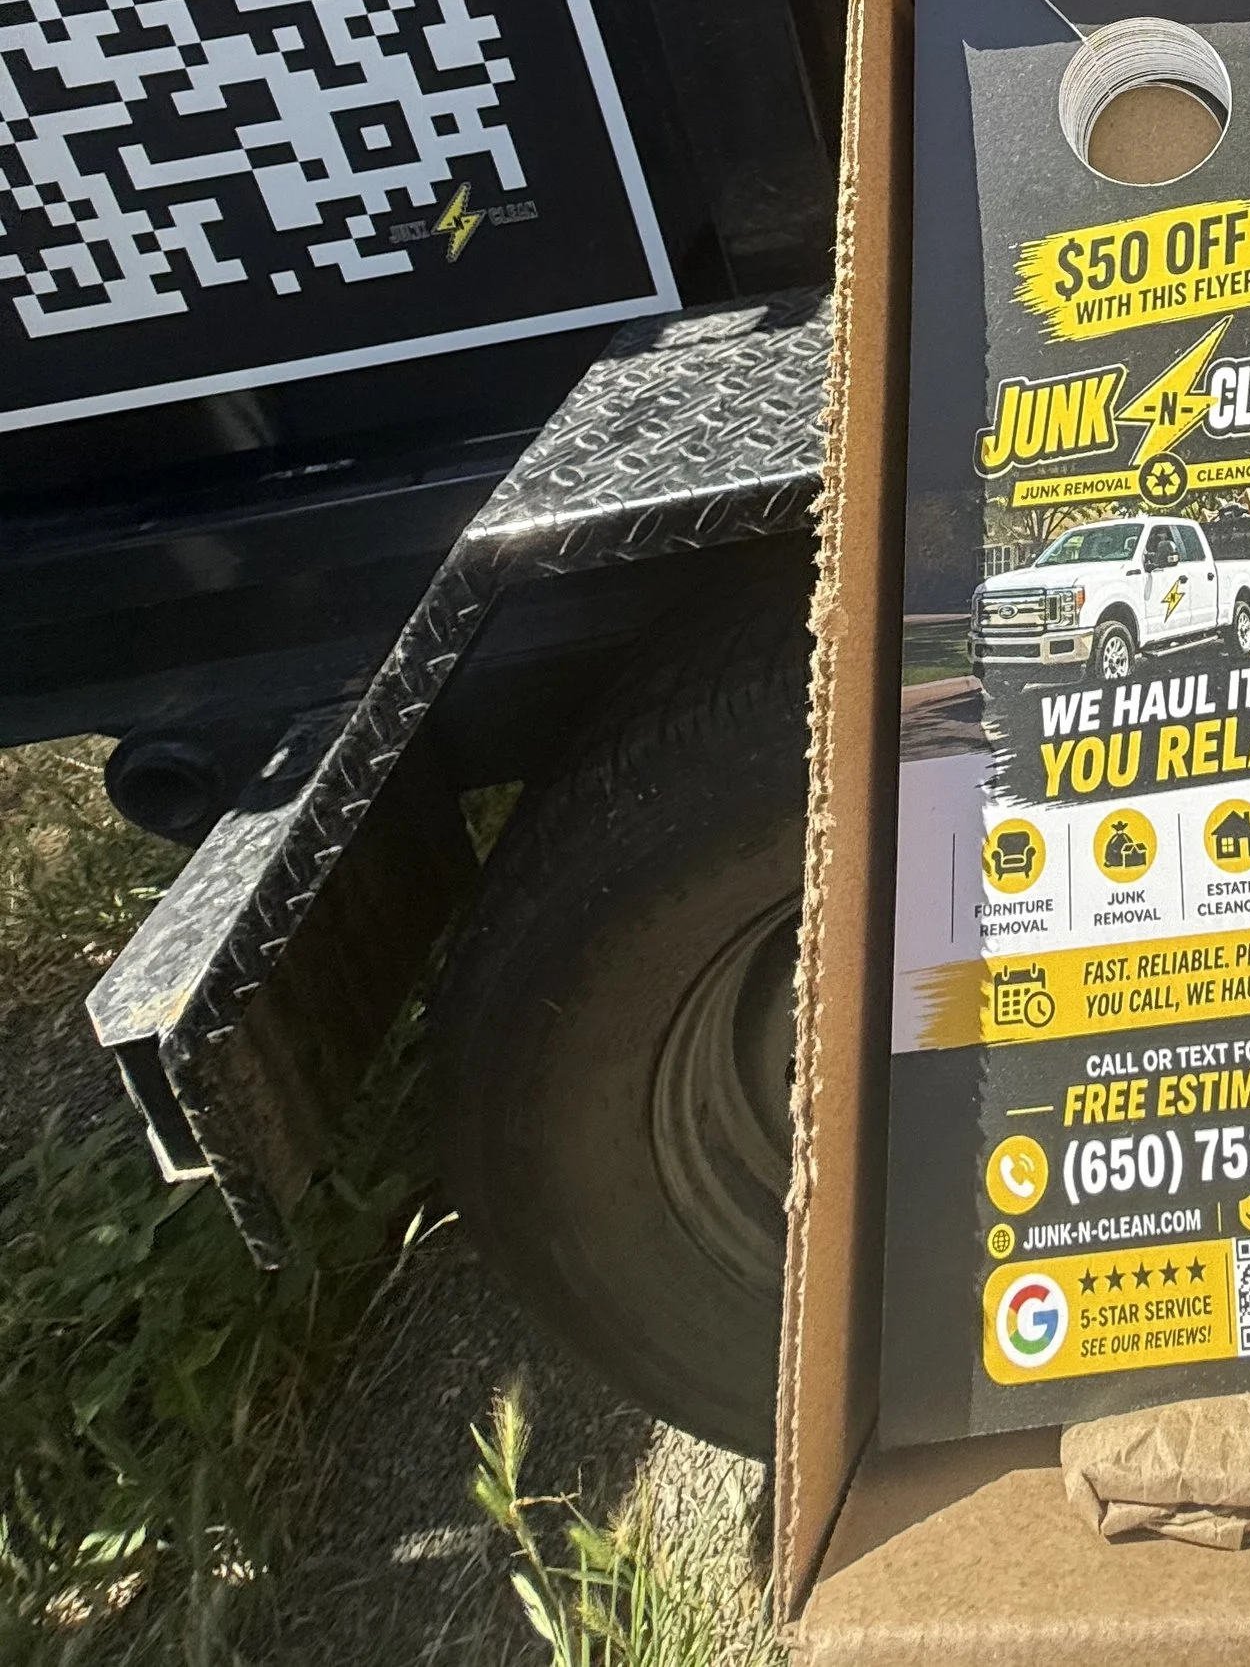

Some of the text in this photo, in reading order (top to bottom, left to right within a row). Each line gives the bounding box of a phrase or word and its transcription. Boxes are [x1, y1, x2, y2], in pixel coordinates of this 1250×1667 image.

[1055, 210, 1249, 302] $50 OFF
[1076, 292, 1131, 324] WITH
[1138, 282, 1186, 313] THIS
[982, 372, 1118, 467] JUNK
[1020, 476, 1132, 501] JUNK REMOVAL
[1041, 687, 1101, 737] WE
[1113, 672, 1216, 728] HAUL
[1040, 729, 1143, 799] YOU
[974, 898, 1054, 919] FURNITURE
[1093, 906, 1161, 927] REMOVAL
[1107, 889, 1145, 907] JUNK
[980, 918, 1048, 937] REMOVAL
[1083, 958, 1131, 986] FAST.
[1137, 947, 1229, 980] RELIABLE.
[1086, 992, 1124, 1019] YOU
[1128, 984, 1180, 1014] CALL,
[1185, 980, 1214, 1005] WE
[1086, 1052, 1139, 1078] CALL
[1143, 1048, 1173, 1071] OR
[1176, 1043, 1228, 1069] TEXT
[1063, 1077, 1147, 1128] FREE
[1063, 1130, 1183, 1206] (650)
[1023, 1209, 1202, 1252] JUNK-N-CLEAN.COM
[1079, 1295, 1212, 1330] 5-STAR SERVICE
[1080, 1327, 1212, 1359] SEE OUR REVIEWS!
